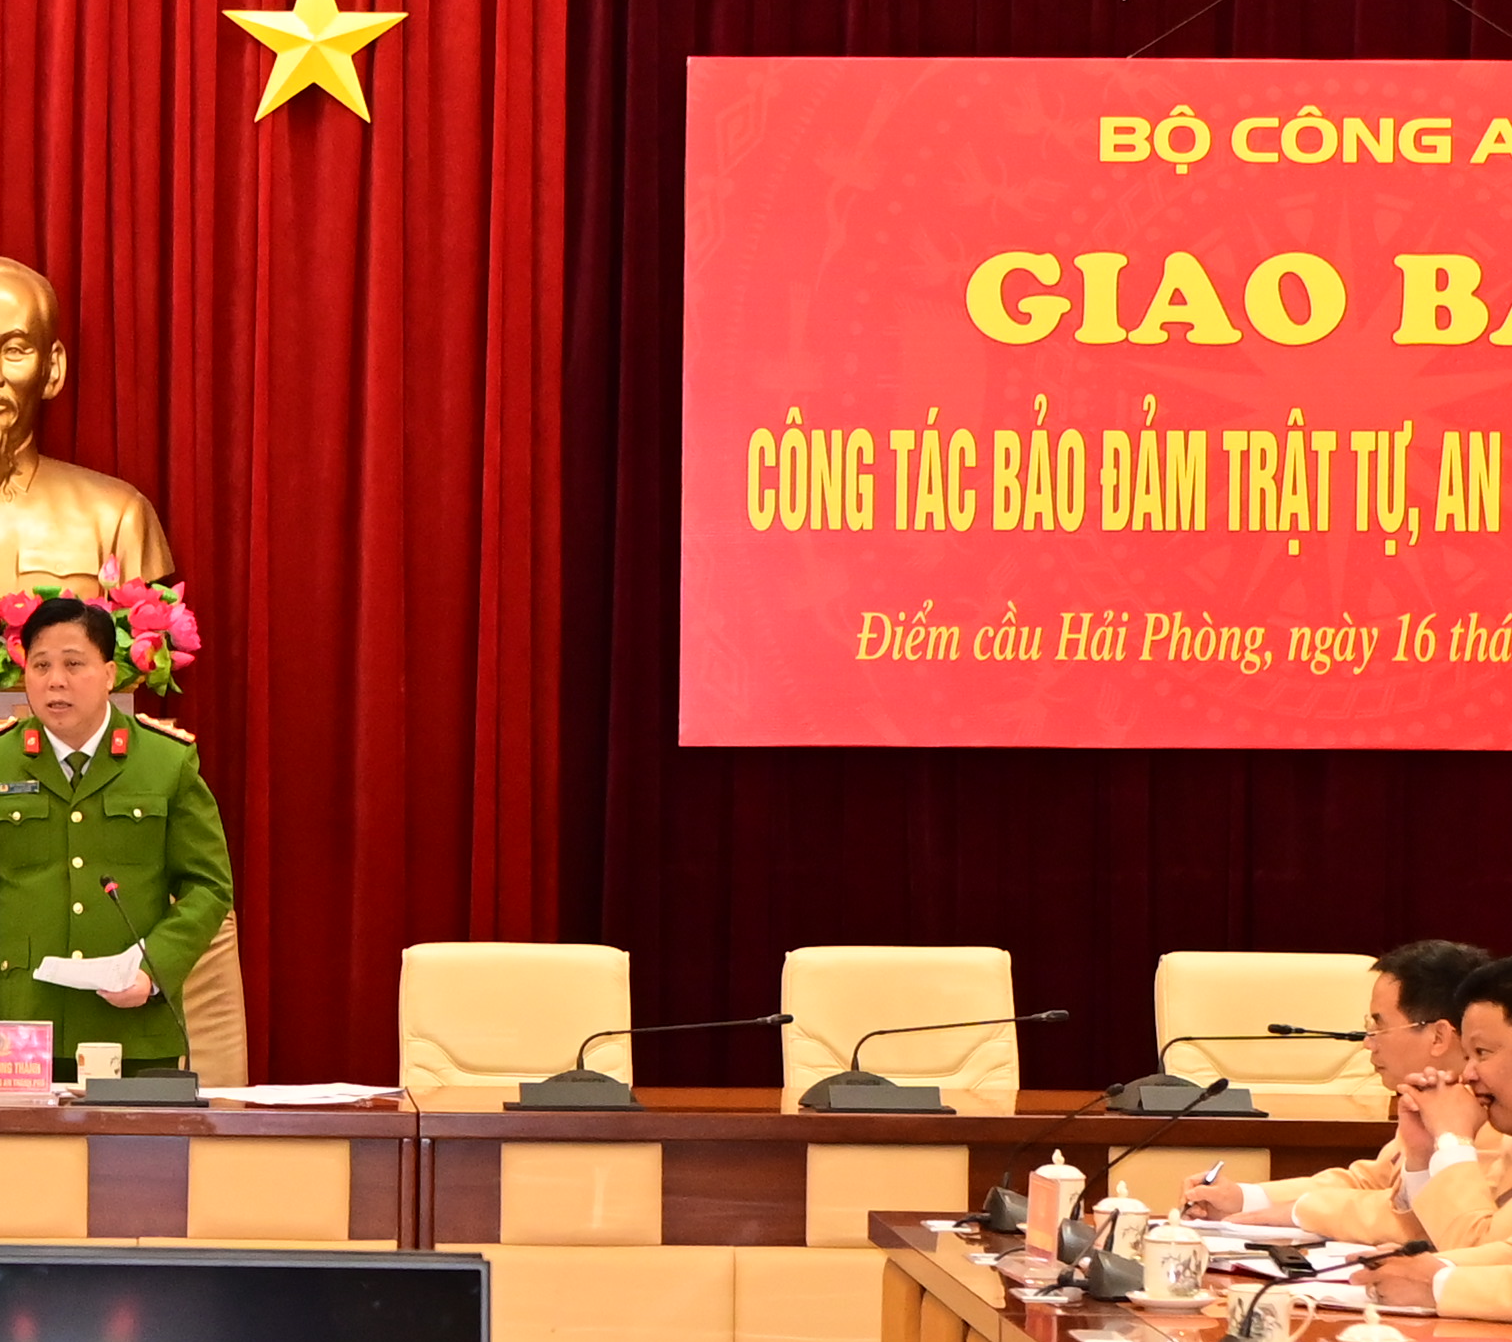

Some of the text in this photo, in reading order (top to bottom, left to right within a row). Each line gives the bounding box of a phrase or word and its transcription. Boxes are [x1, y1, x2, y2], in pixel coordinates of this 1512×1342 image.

[1099, 104, 1211, 175] BỘ
[1231, 104, 1452, 164] CÔNG
[965, 251, 1347, 346] GIAO
[747, 406, 874, 532] CÔNG
[889, 406, 977, 532] TÁC
[992, 393, 1086, 532] BẢO
[1100, 393, 1207, 531] ĐẢM
[1222, 407, 1337, 556] TRẬT
[1350, 419, 1420, 556] TỰ,
[1434, 431, 1501, 532] AN
[855, 598, 960, 661] Điểm
[973, 600, 1043, 661] cầu
[1054, 609, 1129, 662] Hải
[1138, 610, 1273, 675] Phòng,
[1287, 611, 1379, 676] ngày
[1391, 612, 1437, 663] 16
